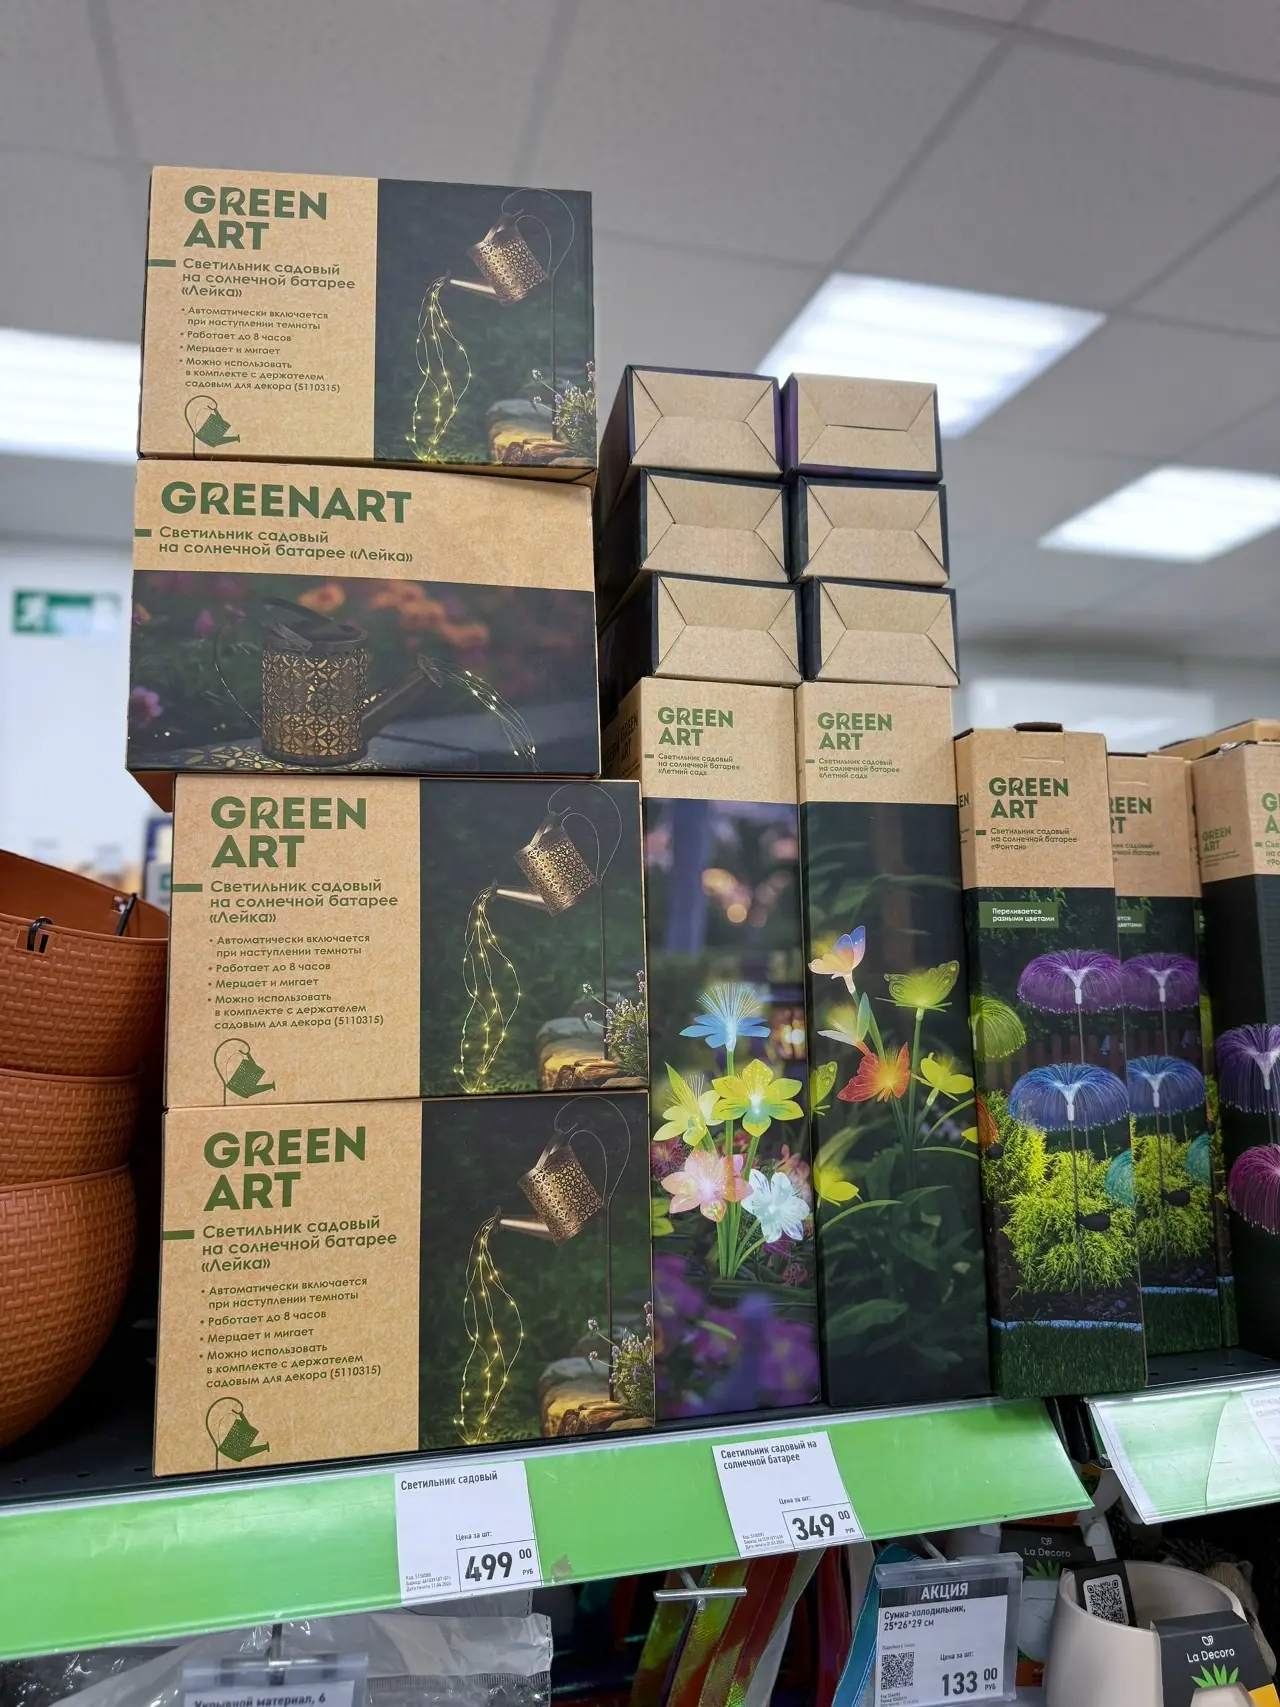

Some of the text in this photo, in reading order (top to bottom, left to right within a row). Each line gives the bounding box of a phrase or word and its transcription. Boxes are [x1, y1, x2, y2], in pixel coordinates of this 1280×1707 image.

[185, 185, 327, 220] GREEN
[184, 219, 269, 250] ART
[183, 258, 340, 275] Светильник садовый
[182, 273, 355, 290] на солнечной батарее
[182, 285, 242, 298] «Лейка»
[188, 307, 328, 319] Автоматически включается
[209, 319, 274, 328] наступлении
[277, 322, 320, 330] темноты
[187, 332, 235, 340] Работает
[187, 344, 280, 355] Мерцает мигает
[186, 358, 292, 368] Можно использовать
[194, 371, 324, 381] комплекте держателем
[185, 381, 232, 389] садовым
[254, 383, 291, 392] декора
[294, 383, 340, 393] (5110315)
[161, 481, 412, 523] GREENART
[160, 526, 328, 544] Светильник садовый
[159, 543, 413, 562] на солнечной батарее «Лейка»
[658, 707, 733, 728] GREEN
[817, 712, 892, 731] GREEN
[658, 727, 703, 746] ART
[819, 733, 863, 750] ART
[658, 753, 733, 763] Светильник садовый
[669, 761, 707, 769] солнечной
[710, 762, 740, 771] батарее
[870, 766, 900, 774] батарее
[989, 777, 1068, 797] GREEN
[211, 796, 366, 830] GREEN
[991, 799, 1037, 818] ART
[1002, 835, 1044, 843] солнечной
[1046, 836, 1077, 844] батарее
[1037, 828, 1070, 836] садовый
[211, 835, 304, 867] ART
[211, 879, 381, 892] Светильник садовый
[210, 894, 398, 908] на солнечной батарее
[210, 911, 276, 923] «Лейка»
[993, 915, 1054, 923] разными цветами
[217, 935, 370, 945] Автоматически включается
[217, 947, 362, 958] при наступлении темноты
[216, 963, 330, 972] Работает часов
[215, 978, 319, 989] Мерцает мигает
[215, 993, 331, 1004] Можно использовать
[224, 1005, 366, 1016] комплекте держателем
[214, 1015, 384, 1030] садовым для декора (5110315)
[204, 1126, 365, 1168] GREEN
[203, 1171, 301, 1211] ART
[203, 1215, 380, 1239] Светильник садовый
[202, 1233, 397, 1255] на солнечной батарее
[201, 1257, 271, 1272] «Лейка»
[209, 1277, 367, 1295] Автоматически включается
[208, 1292, 358, 1310] при наступлении темноты
[208, 1310, 326, 1326] Работает часов
[208, 1328, 314, 1344] Мерцает мигает
[207, 1344, 327, 1360] Можно использовать
[216, 1354, 363, 1373] комплекте держателем
[206, 1365, 381, 1388] садовым для декора (5110315)
[721, 1440, 817, 1458] Светильник садовый на
[724, 1453, 800, 1469] солнечной батарее
[401, 1471, 498, 1490] Светильник садовый
[792, 1514, 834, 1541] 349
[838, 1510, 850, 1520] 00
[456, 1533, 469, 1541] Цена
[1038, 1548, 1071, 1557] Decoro
[465, 1552, 512, 1582] 499
[519, 1549, 532, 1559] 00
[921, 1583, 968, 1600] АКЦИЯ
[884, 1606, 965, 1620] Сумка-холодильник,
[940, 1653, 955, 1661] Цена
[1187, 1647, 1235, 1663] La Decoro
[942, 1668, 997, 1696] 133 00
[257, 1694, 314, 1707] материал,
[319, 1693, 325, 1703] 6
